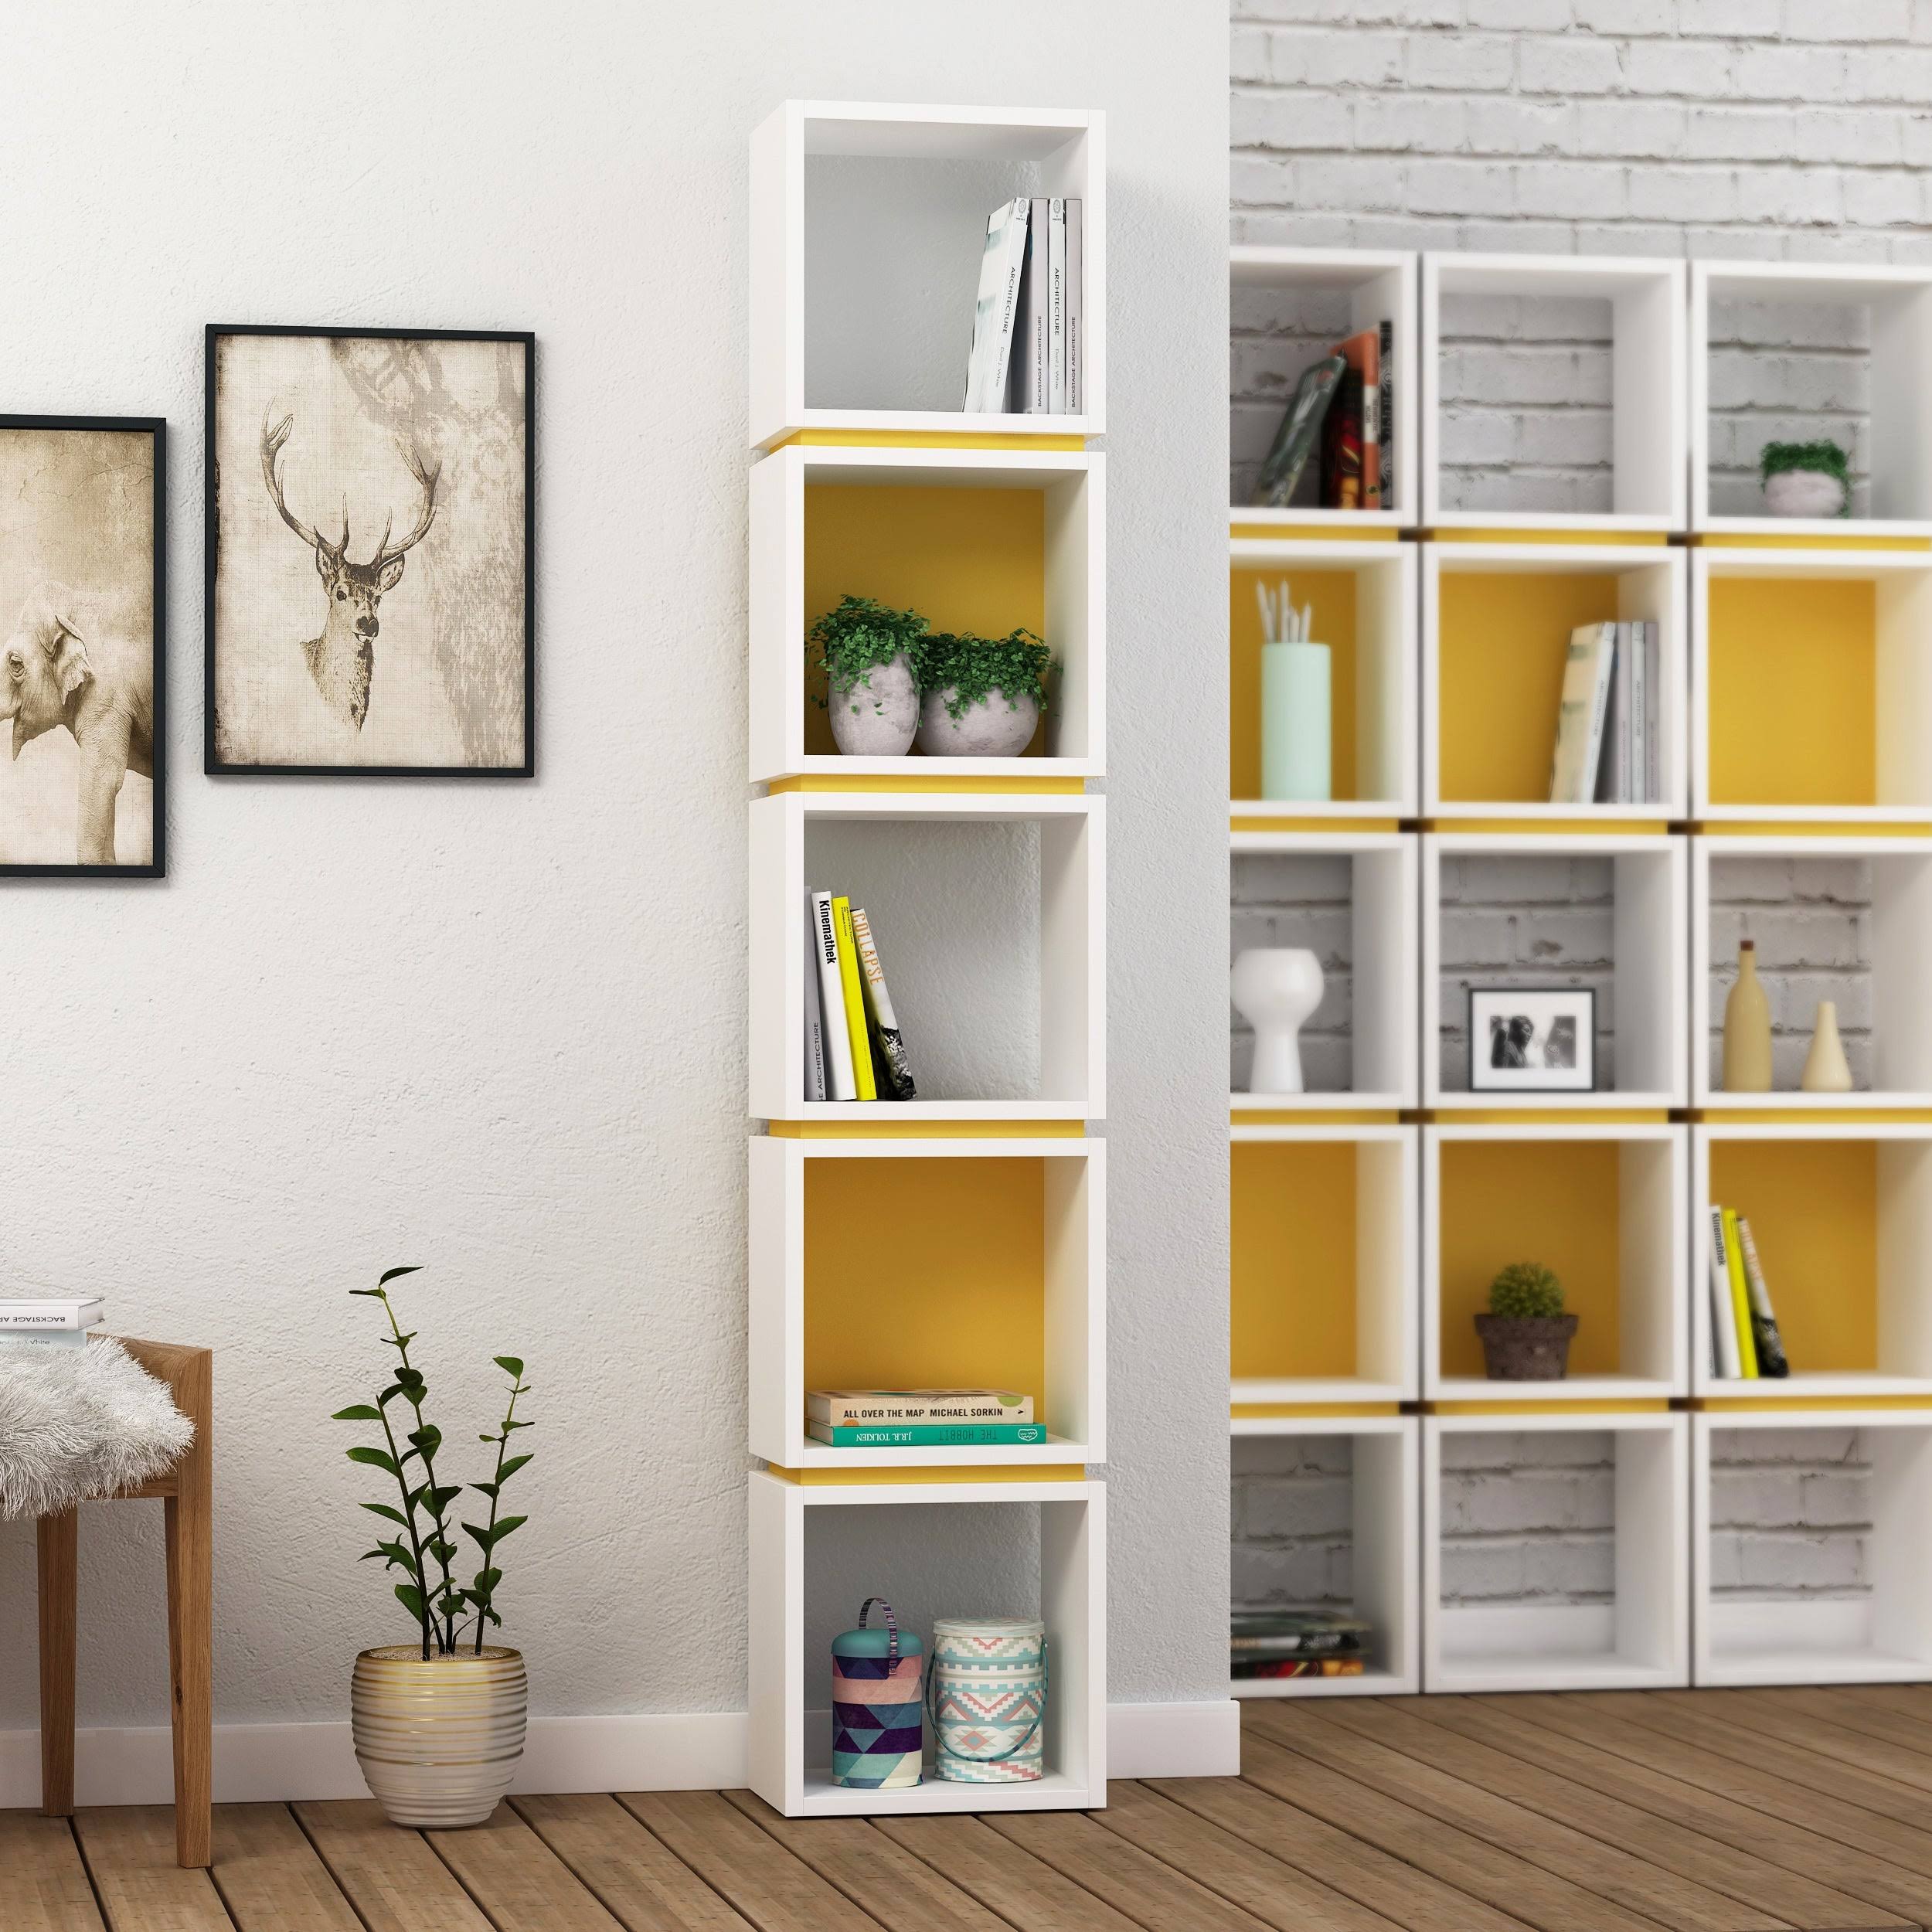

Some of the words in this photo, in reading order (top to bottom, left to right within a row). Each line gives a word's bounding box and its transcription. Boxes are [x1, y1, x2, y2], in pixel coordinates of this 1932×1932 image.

[1002, 267, 1015, 334] ARCHITECTURE
[819, 900, 836, 964] Kinemathek
[852, 913, 884, 985] COLLAPSE
[814, 1022, 823, 1090] ARCHITECTURE
[1712, 1213, 1726, 1266] Kinemathek
[843, 1410, 859, 1418] ALL
[886, 1409, 903, 1417] THE
[905, 1409, 924, 1417] MAP
[930, 1408, 968, 1417] MICHAEL
[971, 1408, 1003, 1417] SORKIN
[856, 1433, 890, 1441] TOLKIEN
[893, 1431, 912, 1441] J.R.R.
[939, 1430, 974, 1440] HOBBIT
[981, 1429, 997, 1440] THE
